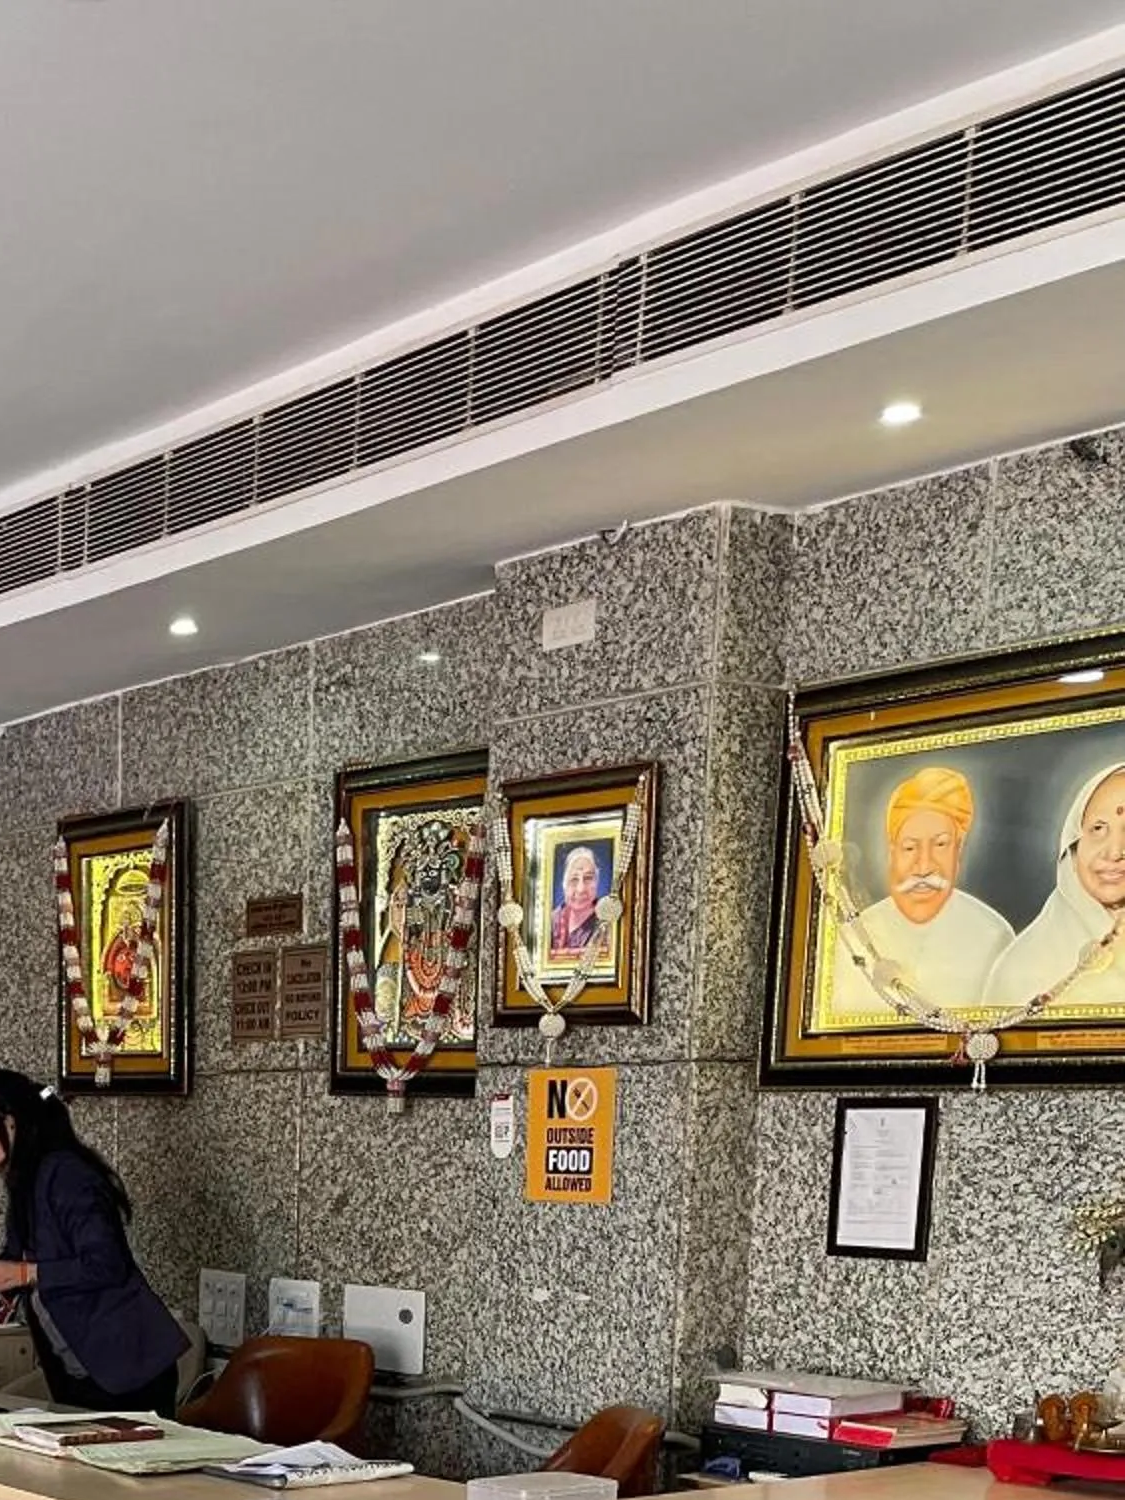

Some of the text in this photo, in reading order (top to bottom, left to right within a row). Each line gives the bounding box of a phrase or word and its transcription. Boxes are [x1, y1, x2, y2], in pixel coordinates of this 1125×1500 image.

[236, 963, 261, 976] CHECK
[234, 1001, 270, 1015] CHECK OUT
[285, 1008, 320, 1021] POLICY
[546, 1127, 594, 1144] OUTSIDE
[548, 1149, 591, 1172] FOOD
[545, 1175, 592, 1192] ALLOWED
